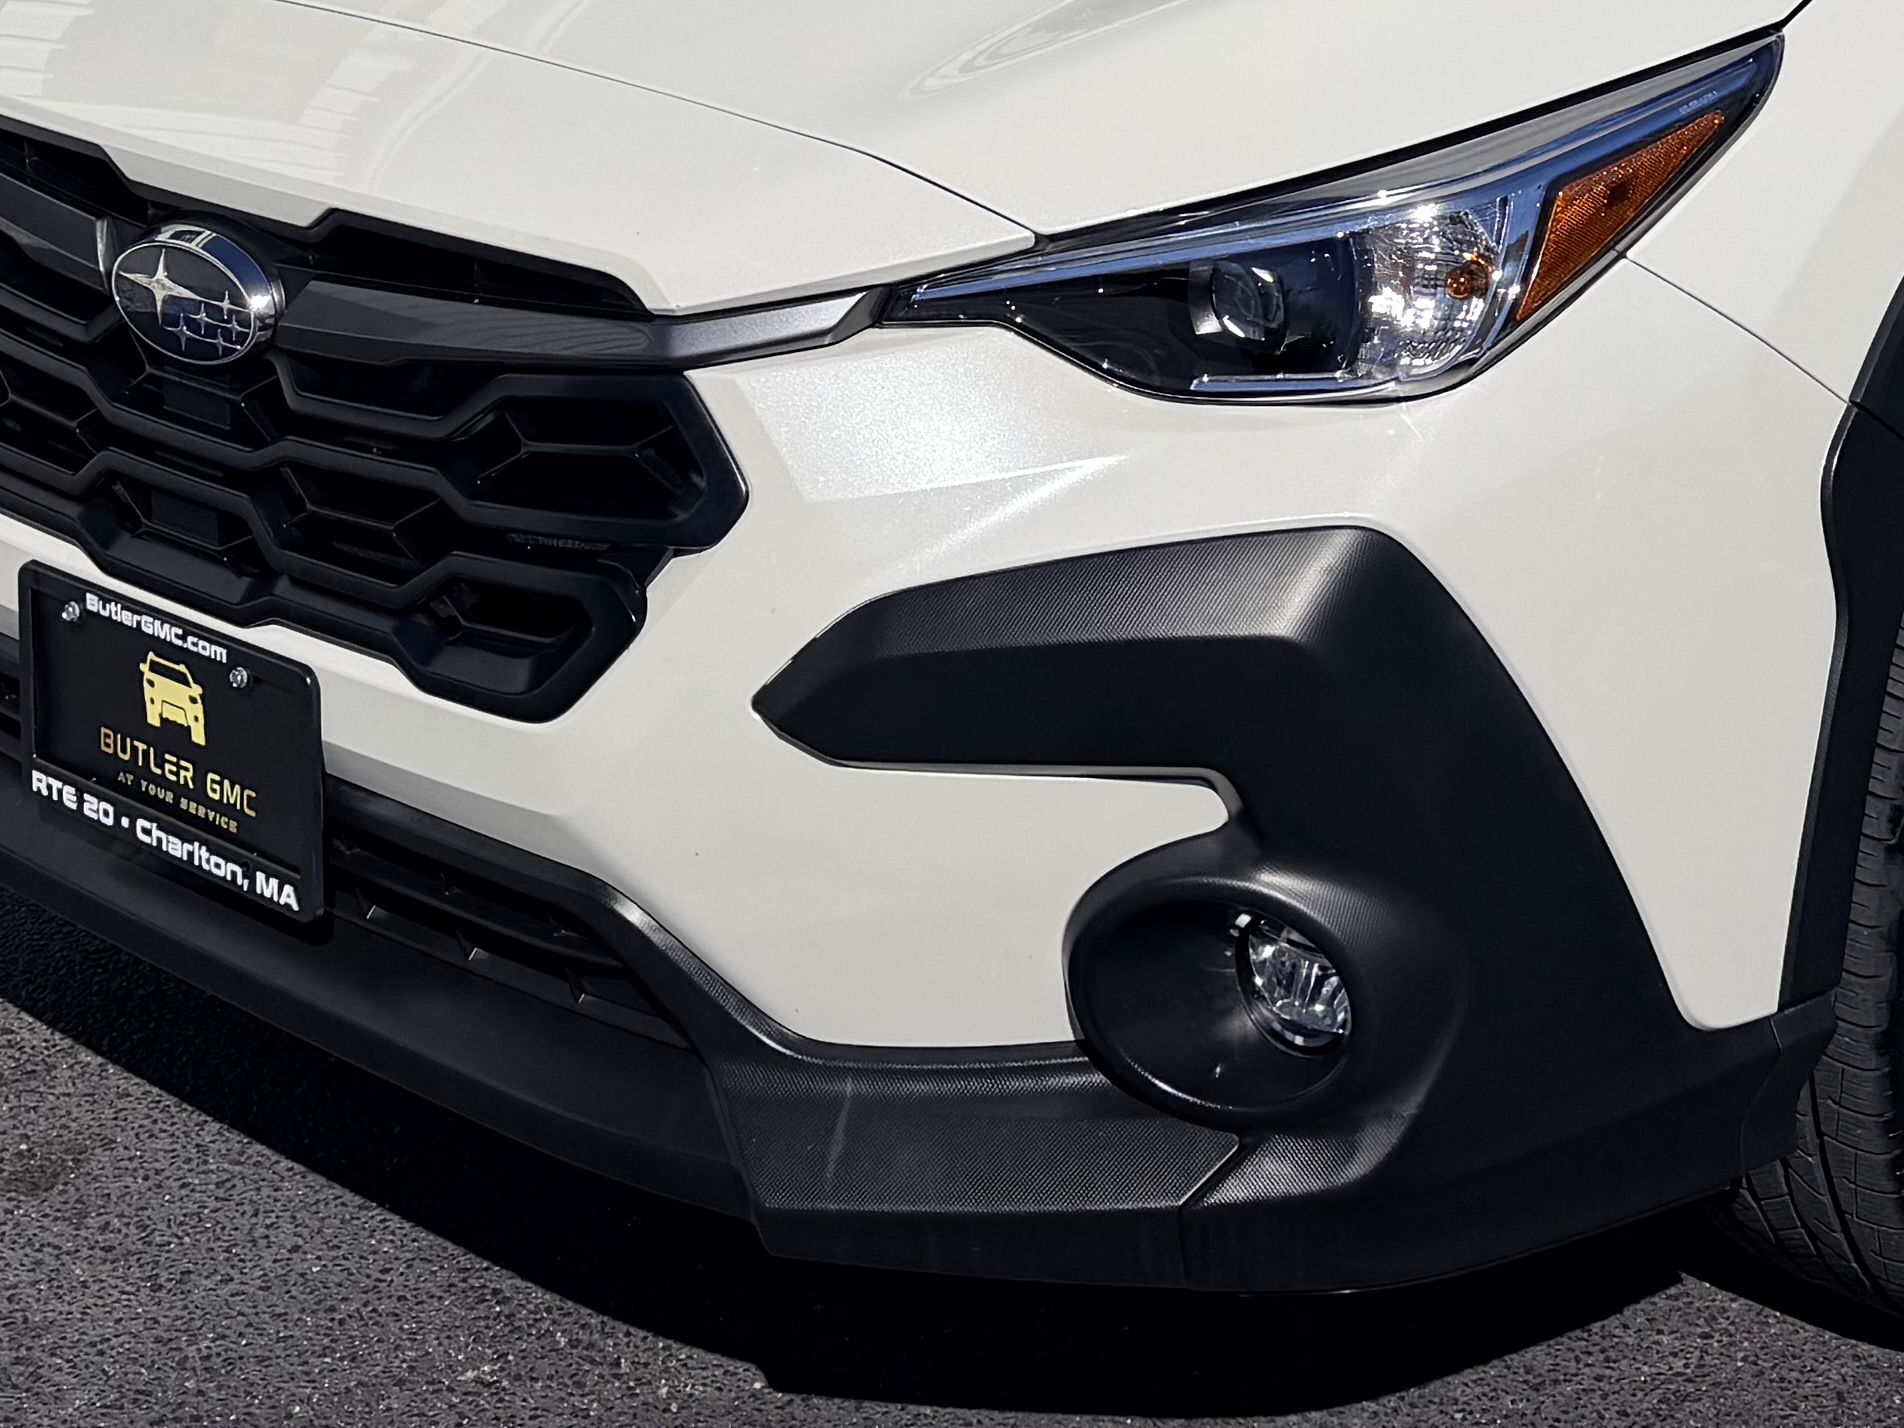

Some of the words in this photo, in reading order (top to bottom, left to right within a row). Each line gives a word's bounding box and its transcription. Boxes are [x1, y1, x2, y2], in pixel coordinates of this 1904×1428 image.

[85, 592, 228, 664] ButlerGMC.com
[100, 726, 194, 789] BUTLER
[206, 772, 257, 818] GMC
[117, 770, 134, 786] AT
[141, 780, 174, 803] YOUR
[180, 795, 238, 833] SERVICE
[32, 770, 78, 809] RTE
[83, 792, 114, 827] 20
[136, 818, 249, 891] Charlton,
[256, 871, 300, 912] MA
